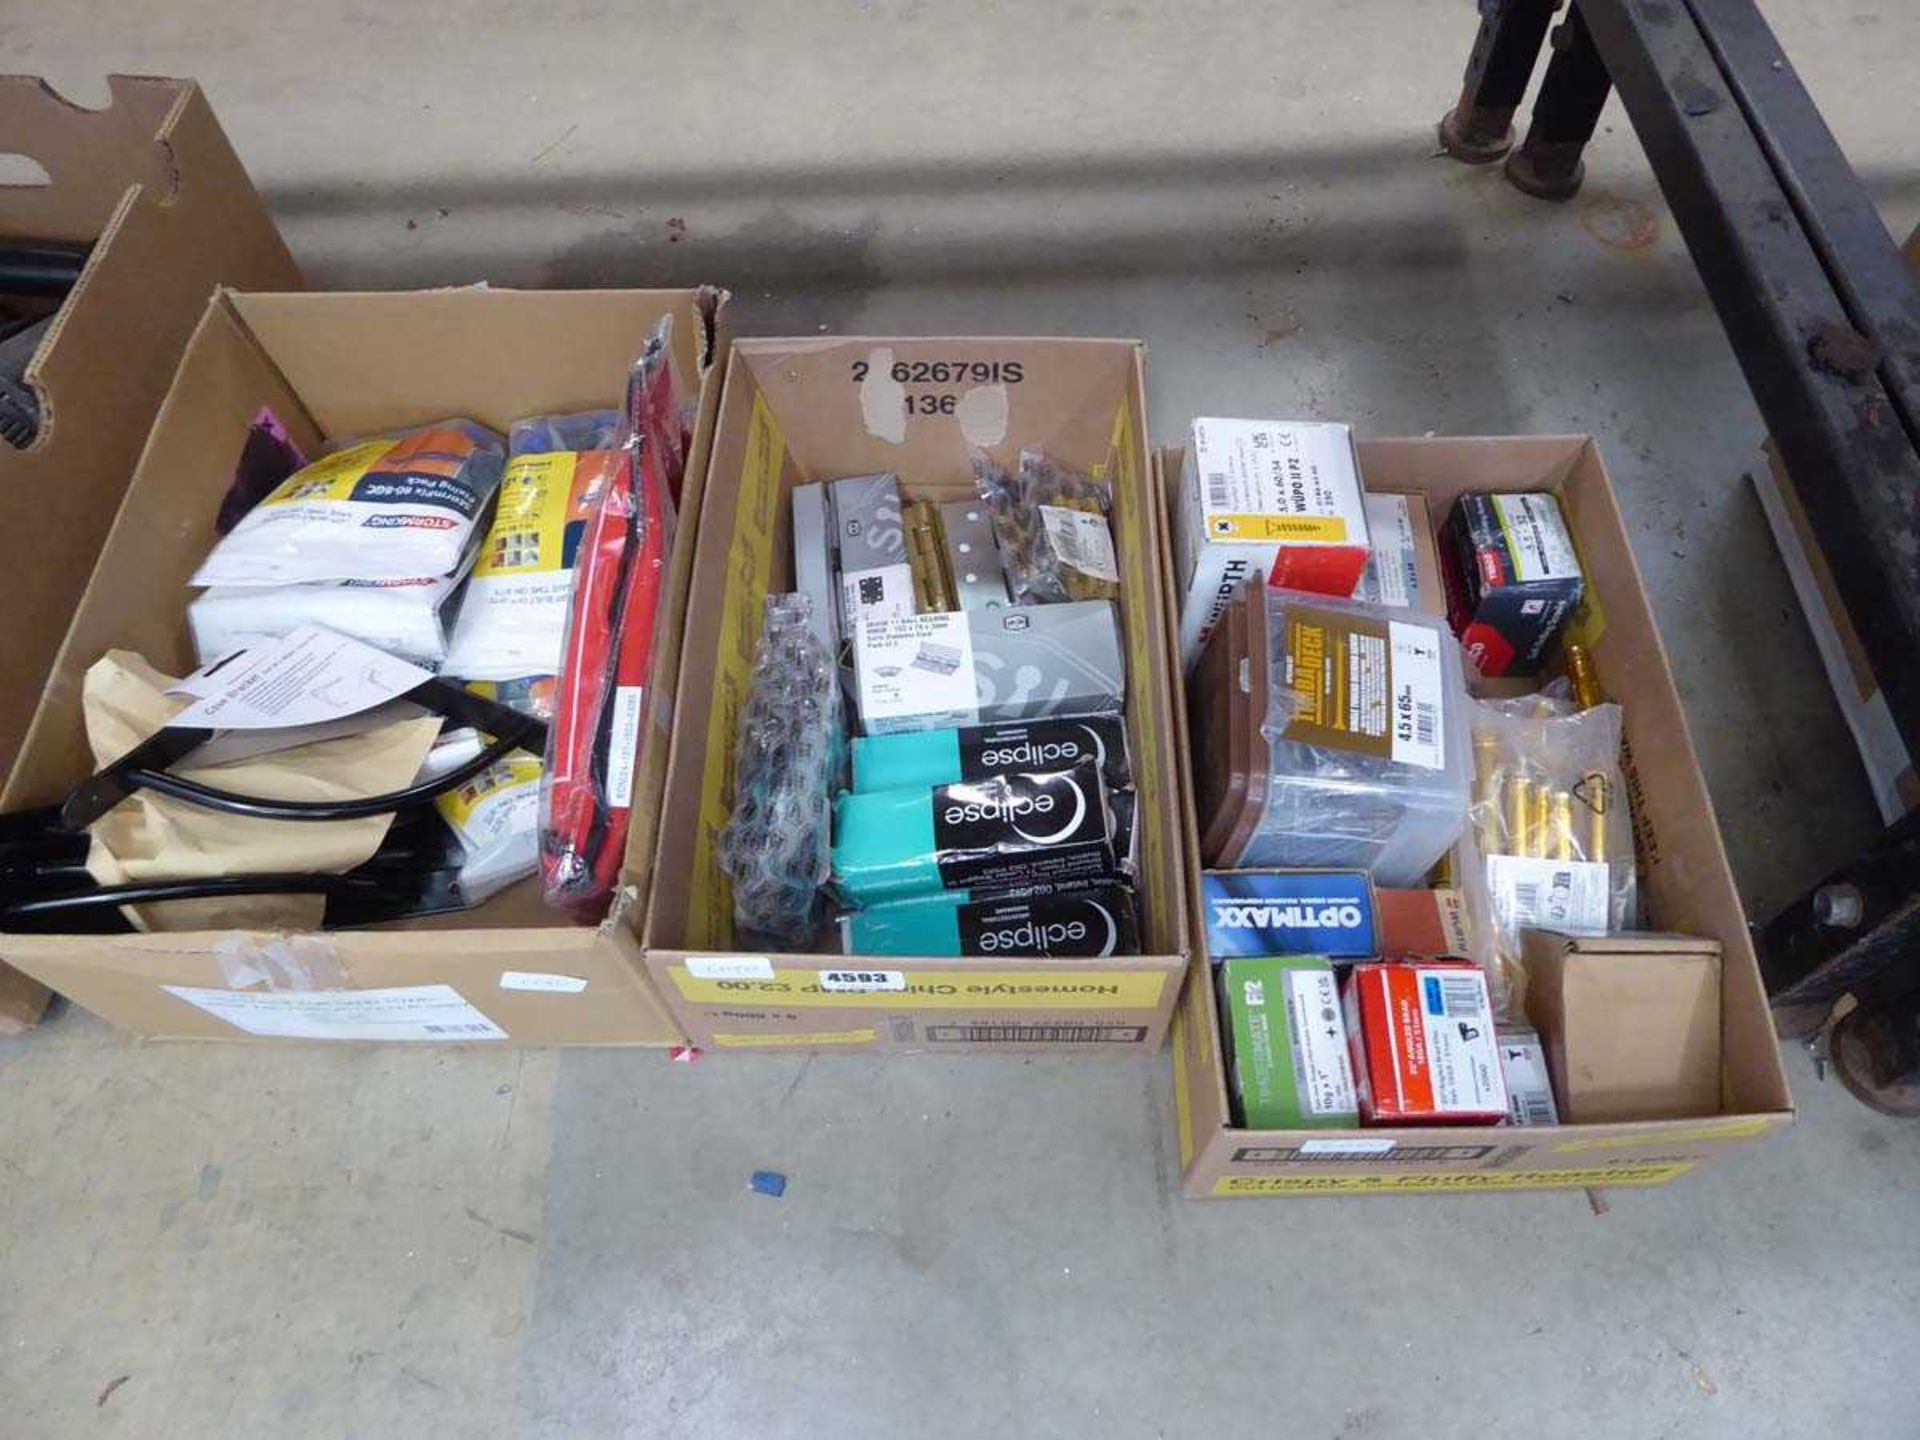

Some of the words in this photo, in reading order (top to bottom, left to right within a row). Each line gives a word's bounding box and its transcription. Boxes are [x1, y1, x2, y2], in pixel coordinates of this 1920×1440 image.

[852, 361, 1024, 383] 262679IS
[905, 394, 958, 415] 136
[365, 514, 452, 530] STORMKING
[981, 741, 1079, 766] eclipse
[943, 794, 1054, 825] eclipse
[1214, 905, 1362, 928] OPTIMAXX
[979, 921, 1086, 951] eclipse
[828, 972, 888, 983] 4593
[967, 984, 1119, 994] Homestyle
